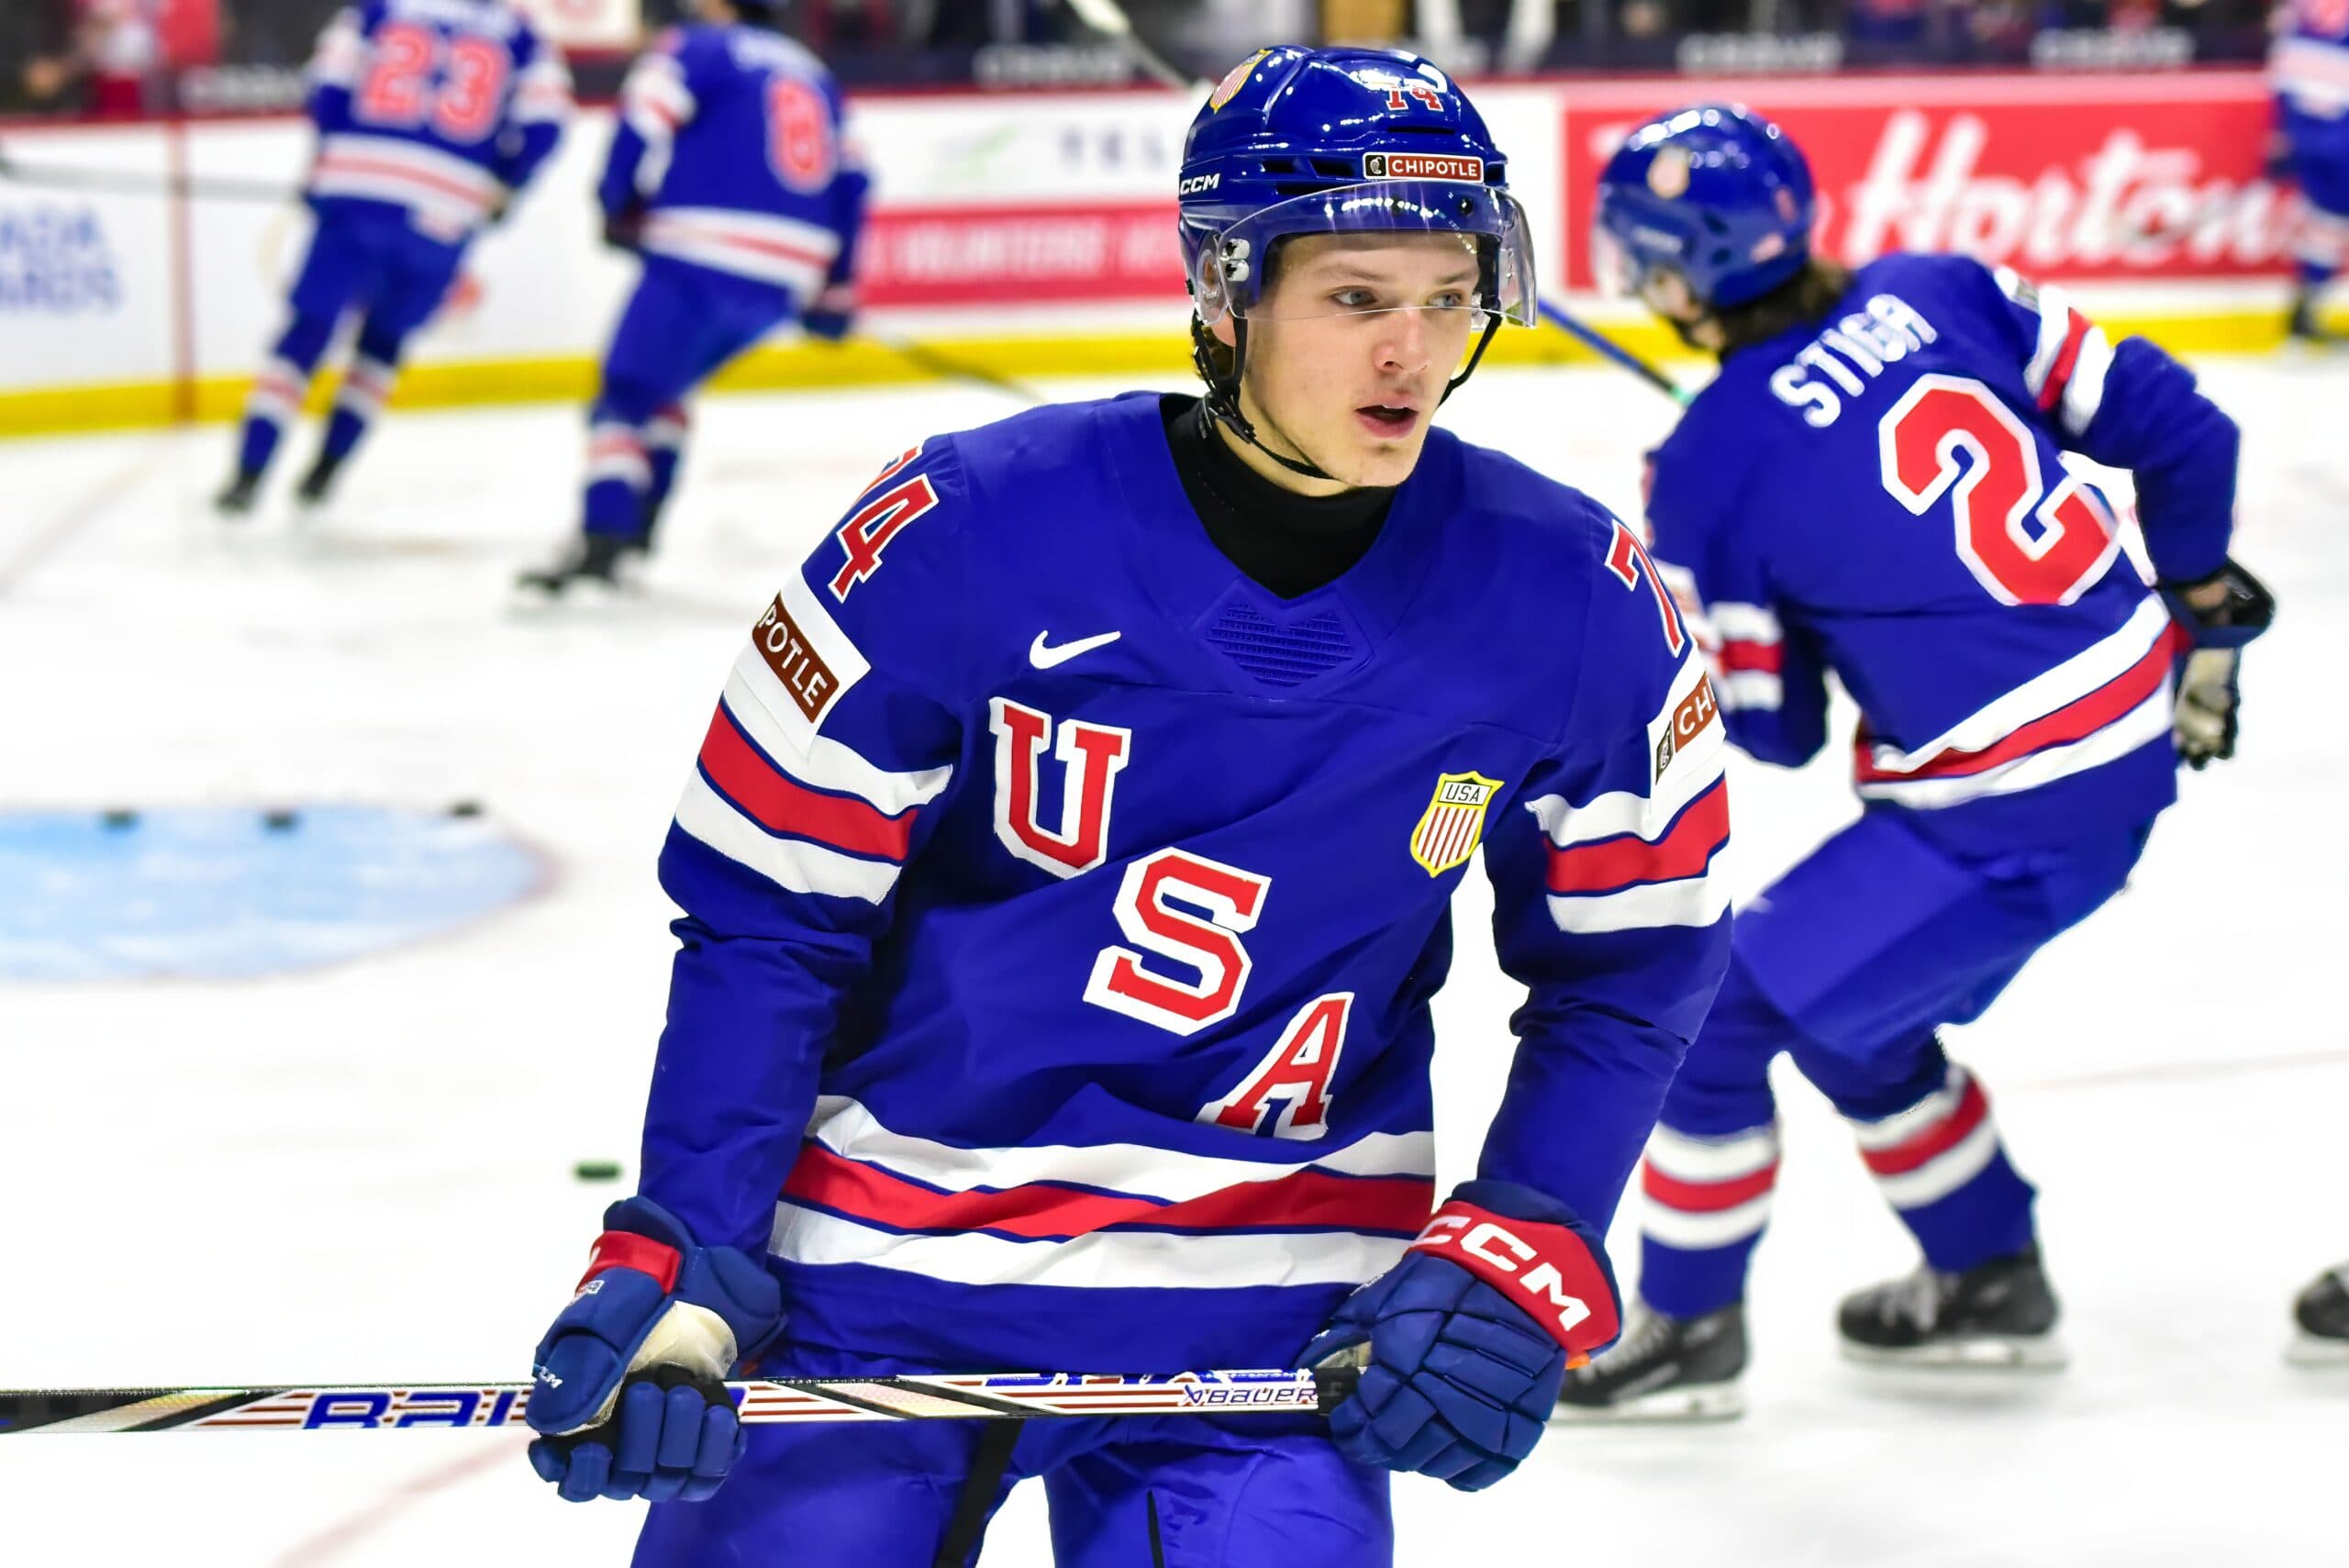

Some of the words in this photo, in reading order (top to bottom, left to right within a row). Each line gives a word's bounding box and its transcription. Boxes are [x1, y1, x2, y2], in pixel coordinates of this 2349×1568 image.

[356, 20, 510, 145] 23
[1180, 172, 1220, 195] CCM
[1392, 160, 1478, 177] CHIPOTLE
[1769, 293, 1939, 428] STIGA
[1877, 372, 2121, 607] 2
[1445, 784, 1481, 803] USA
[1413, 1215, 1592, 1332] CCM
